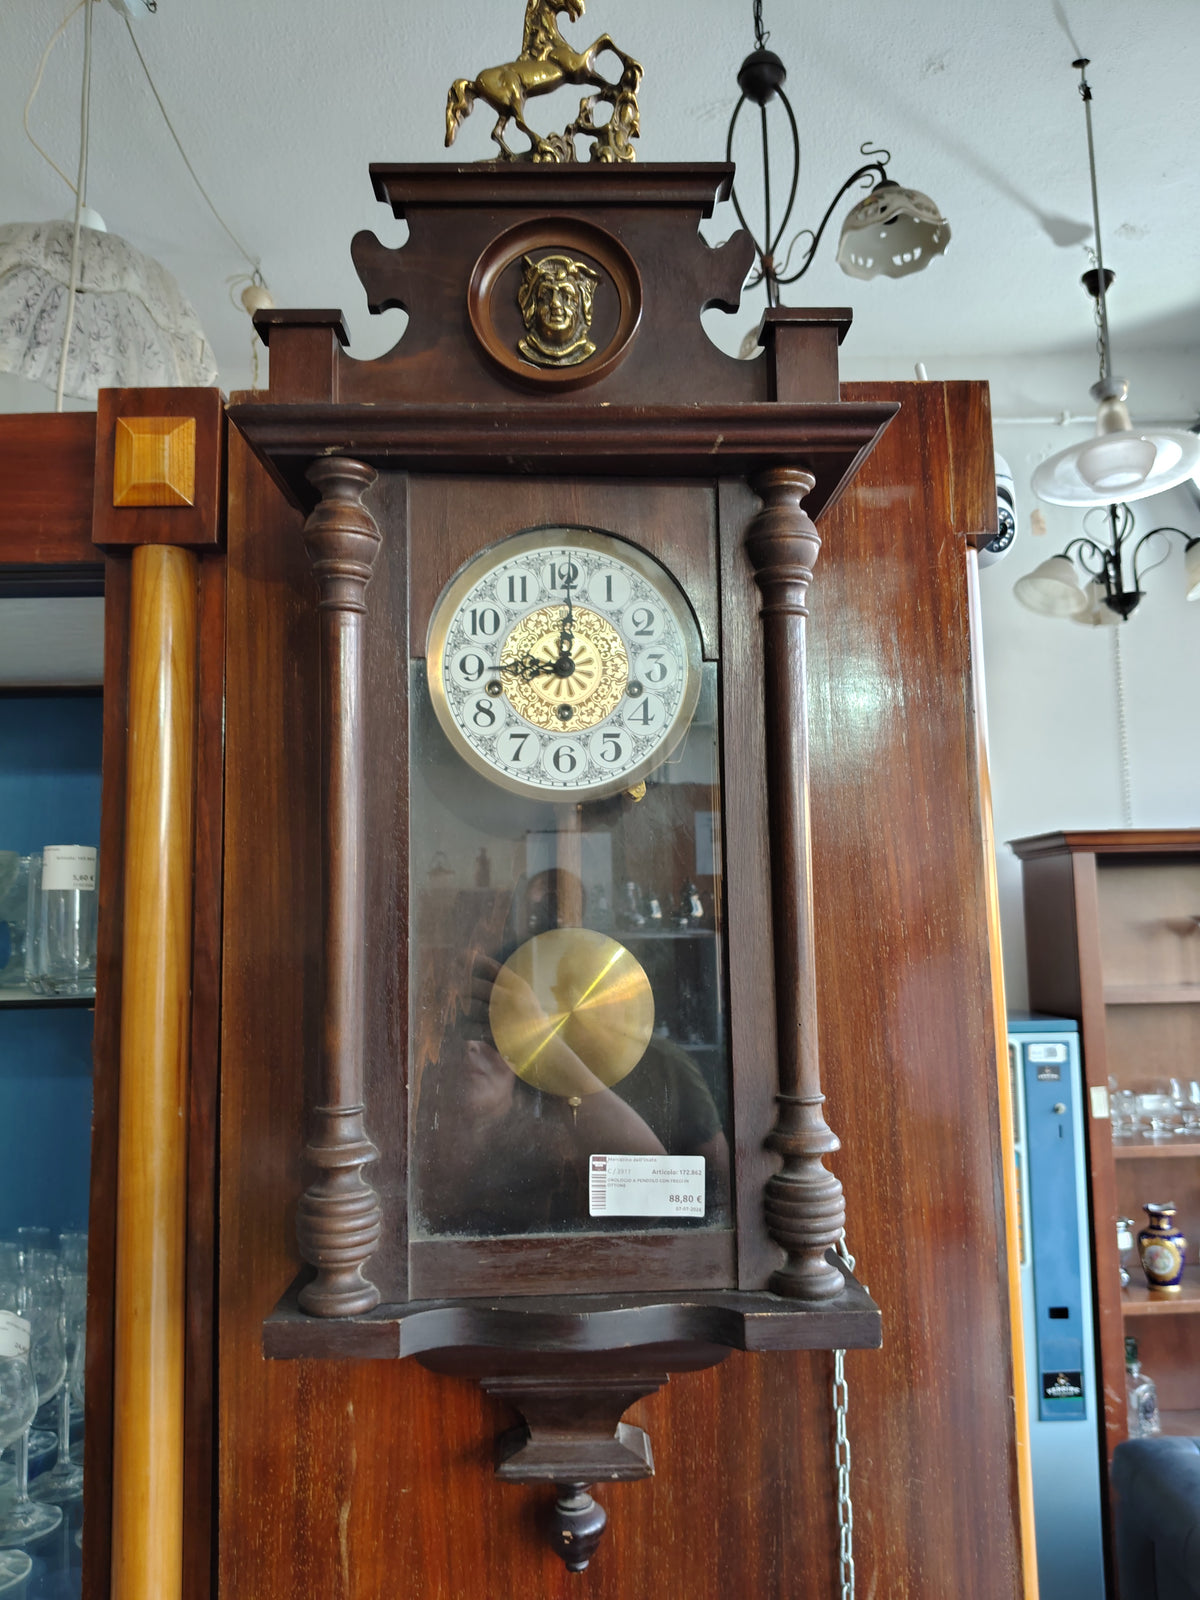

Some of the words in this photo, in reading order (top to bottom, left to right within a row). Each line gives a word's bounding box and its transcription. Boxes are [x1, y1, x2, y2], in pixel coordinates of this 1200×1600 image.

[507, 575, 528, 602] 11
[549, 563, 579, 590] 12
[605, 575, 613, 602] 1
[470, 608, 500, 635] 10
[632, 608, 655, 636] 2
[459, 654, 484, 681] 9
[645, 654, 668, 682] 3
[473, 699, 495, 727] 8
[628, 697, 654, 726] 4
[510, 733, 530, 761] 7
[553, 745, 576, 773] 6
[600, 733, 622, 762] 5
[669, 1195, 693, 1203] 88,80
[696, 1195, 702, 1203] €
